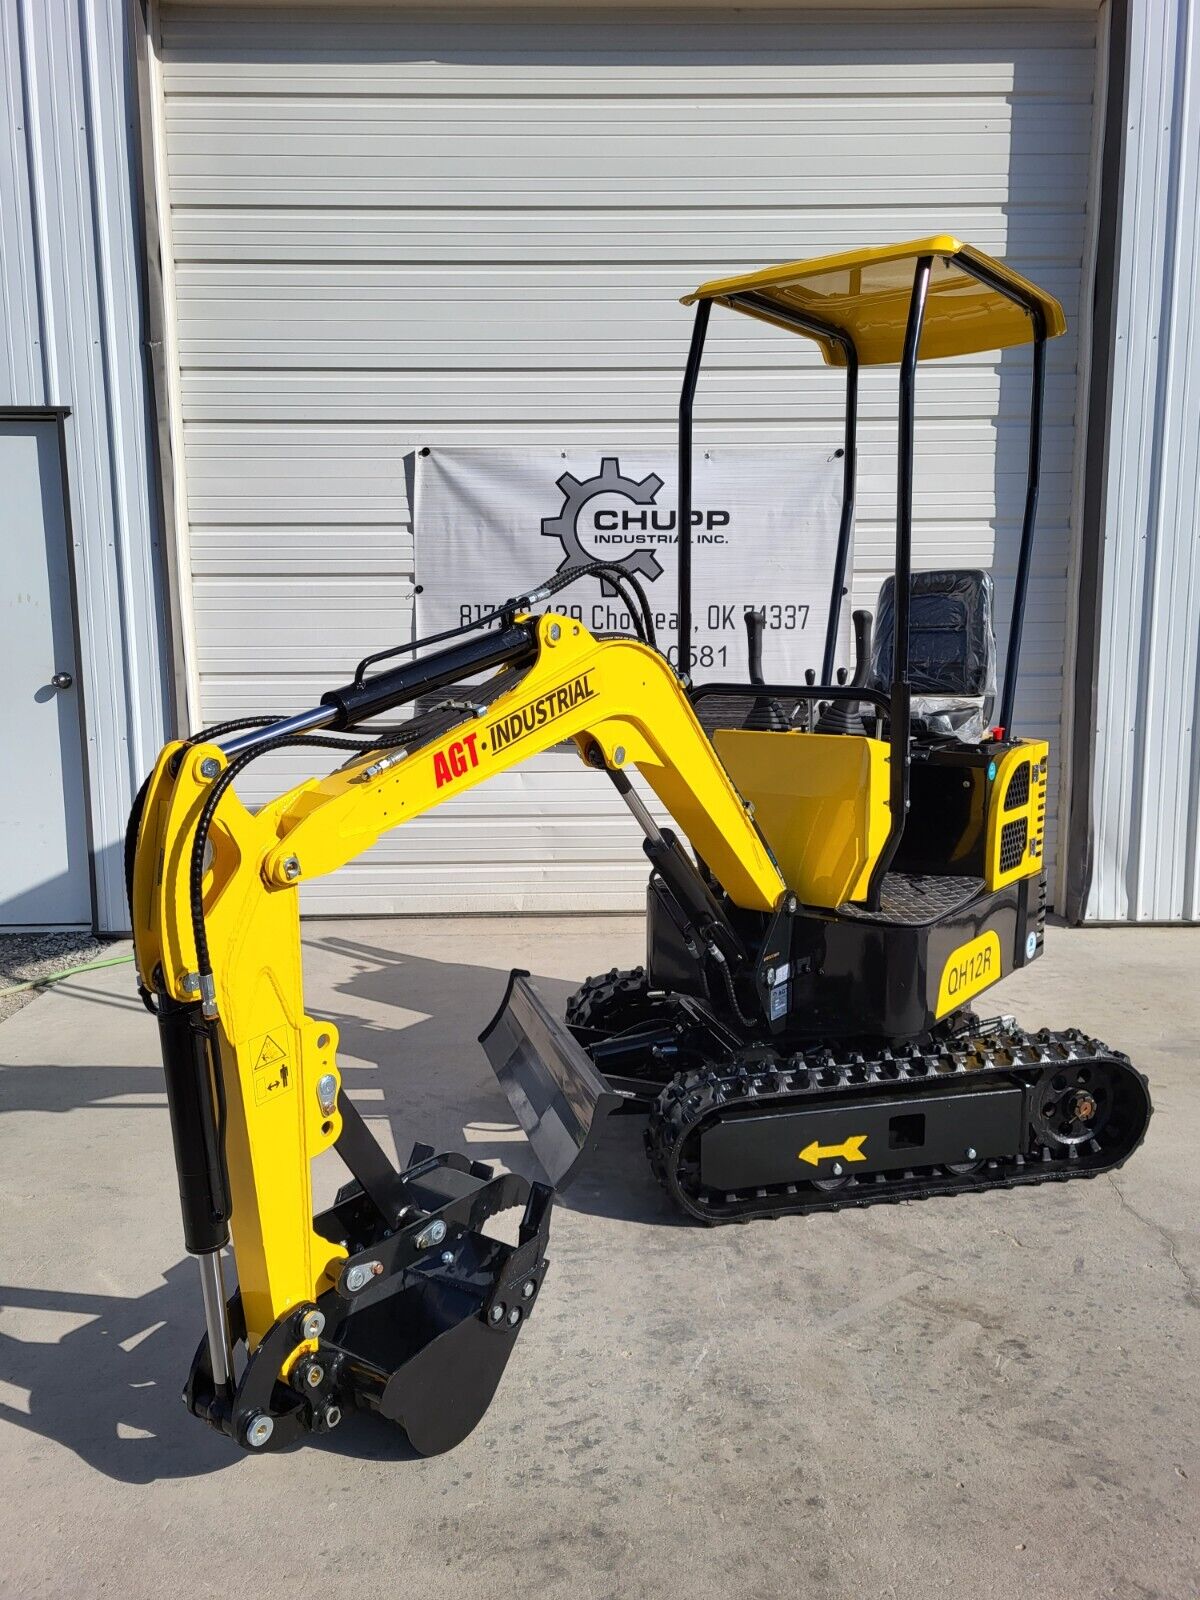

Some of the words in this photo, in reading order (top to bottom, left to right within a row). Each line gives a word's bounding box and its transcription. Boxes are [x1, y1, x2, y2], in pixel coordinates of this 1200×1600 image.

[697, 535, 729, 544] INC.
[592, 604, 699, 633] Choea,
[708, 604, 736, 630] OK
[433, 732, 479, 789] AGT
[489, 676, 594, 751] INDUSTRIAL
[947, 946, 992, 996] QH12R
